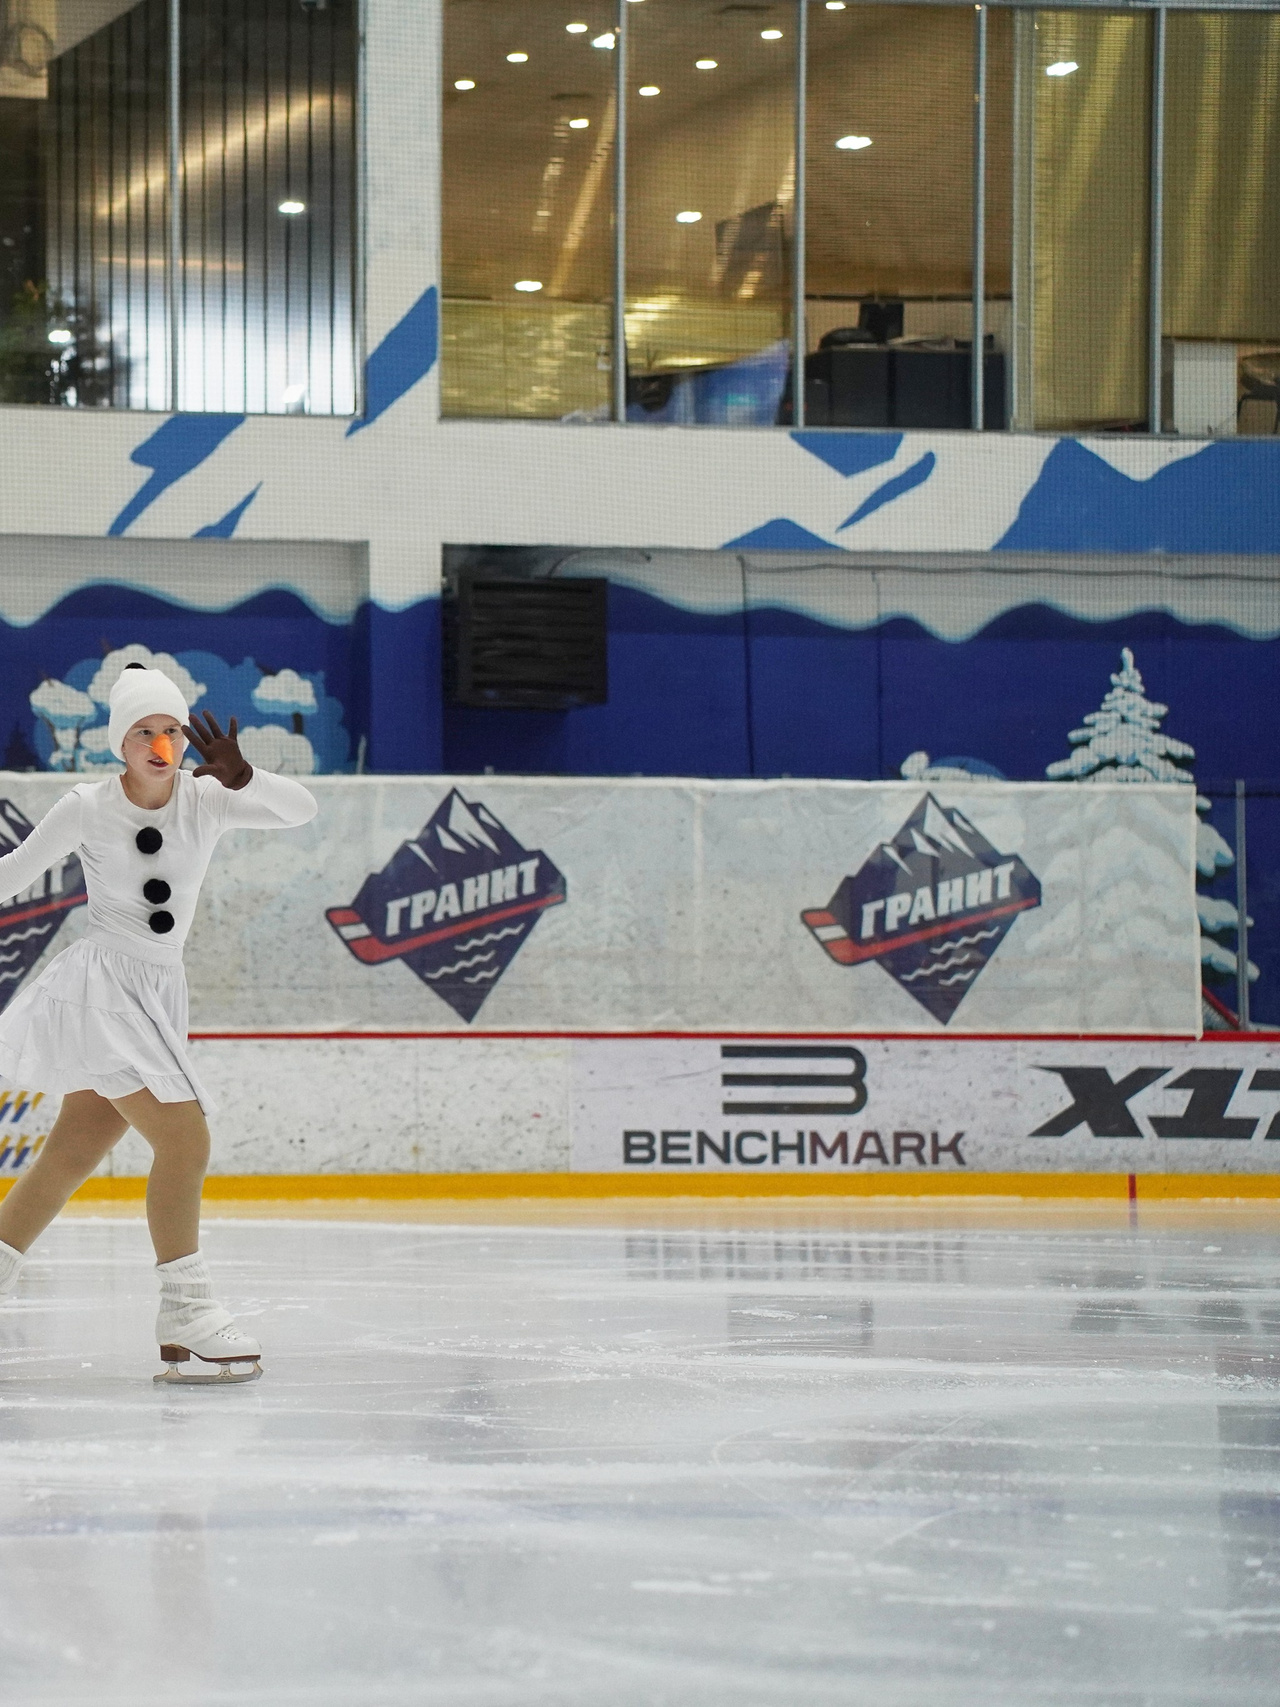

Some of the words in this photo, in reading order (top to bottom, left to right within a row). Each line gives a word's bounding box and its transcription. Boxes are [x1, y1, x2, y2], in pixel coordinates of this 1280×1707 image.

[385, 857, 540, 937] ГРАНИТ
[860, 861, 1015, 939] ГРАНИТ
[623, 1130, 967, 1165] BENCHMARK
